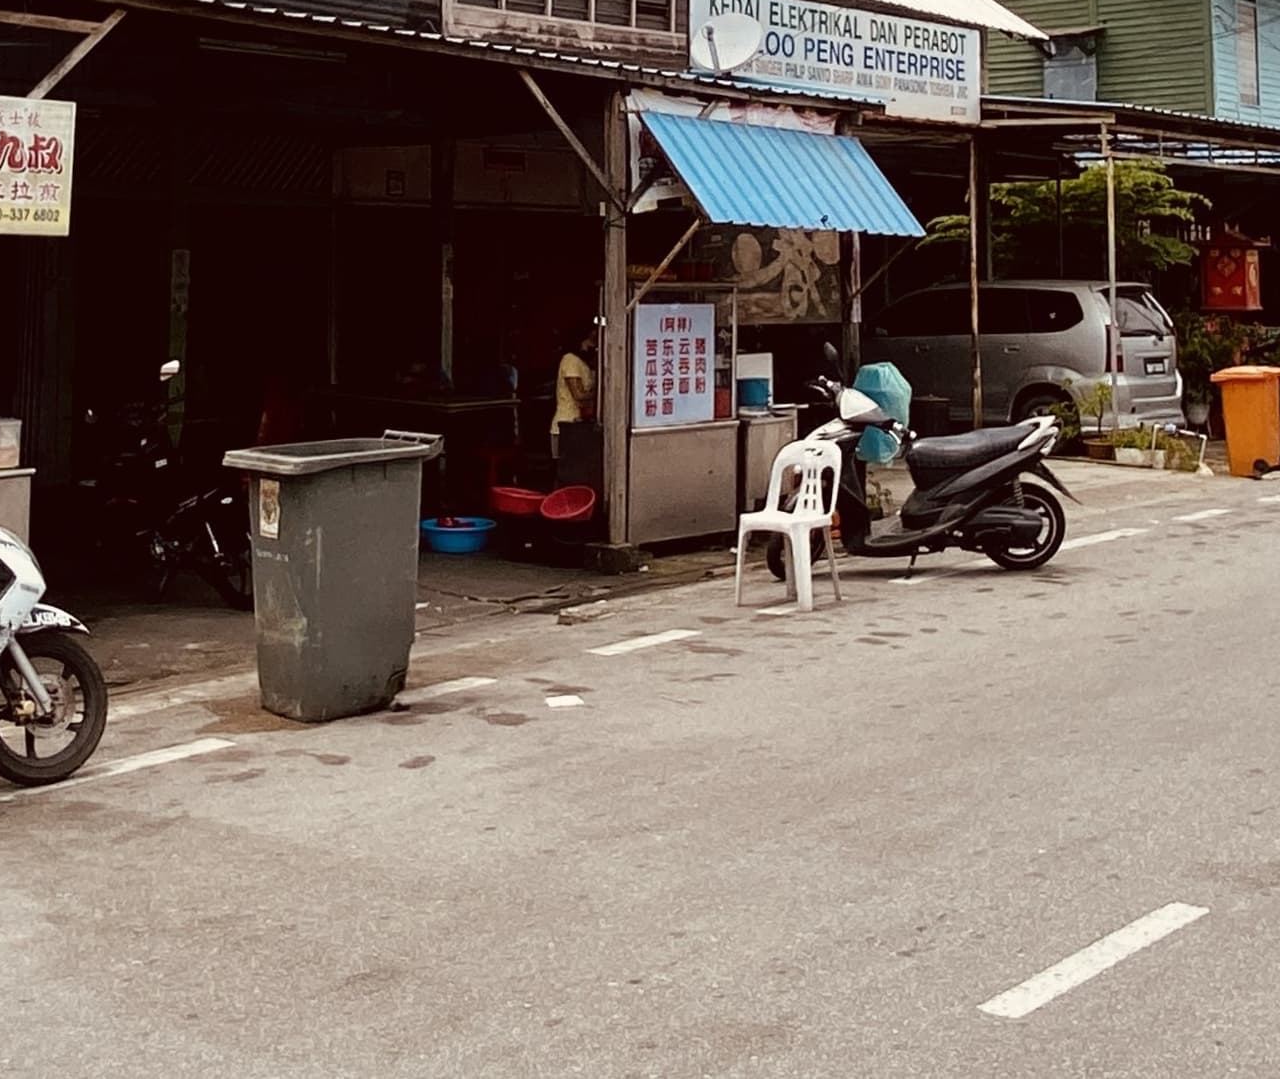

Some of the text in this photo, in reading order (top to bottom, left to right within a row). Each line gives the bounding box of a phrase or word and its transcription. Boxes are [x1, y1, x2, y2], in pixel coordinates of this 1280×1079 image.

[769, 2, 862, 40] ELEKTRIKAL
[870, 19, 898, 45] DAN
[904, 25, 966, 56] PERABOT
[758, 31, 965, 82] OO PENG ENTERPRISE
